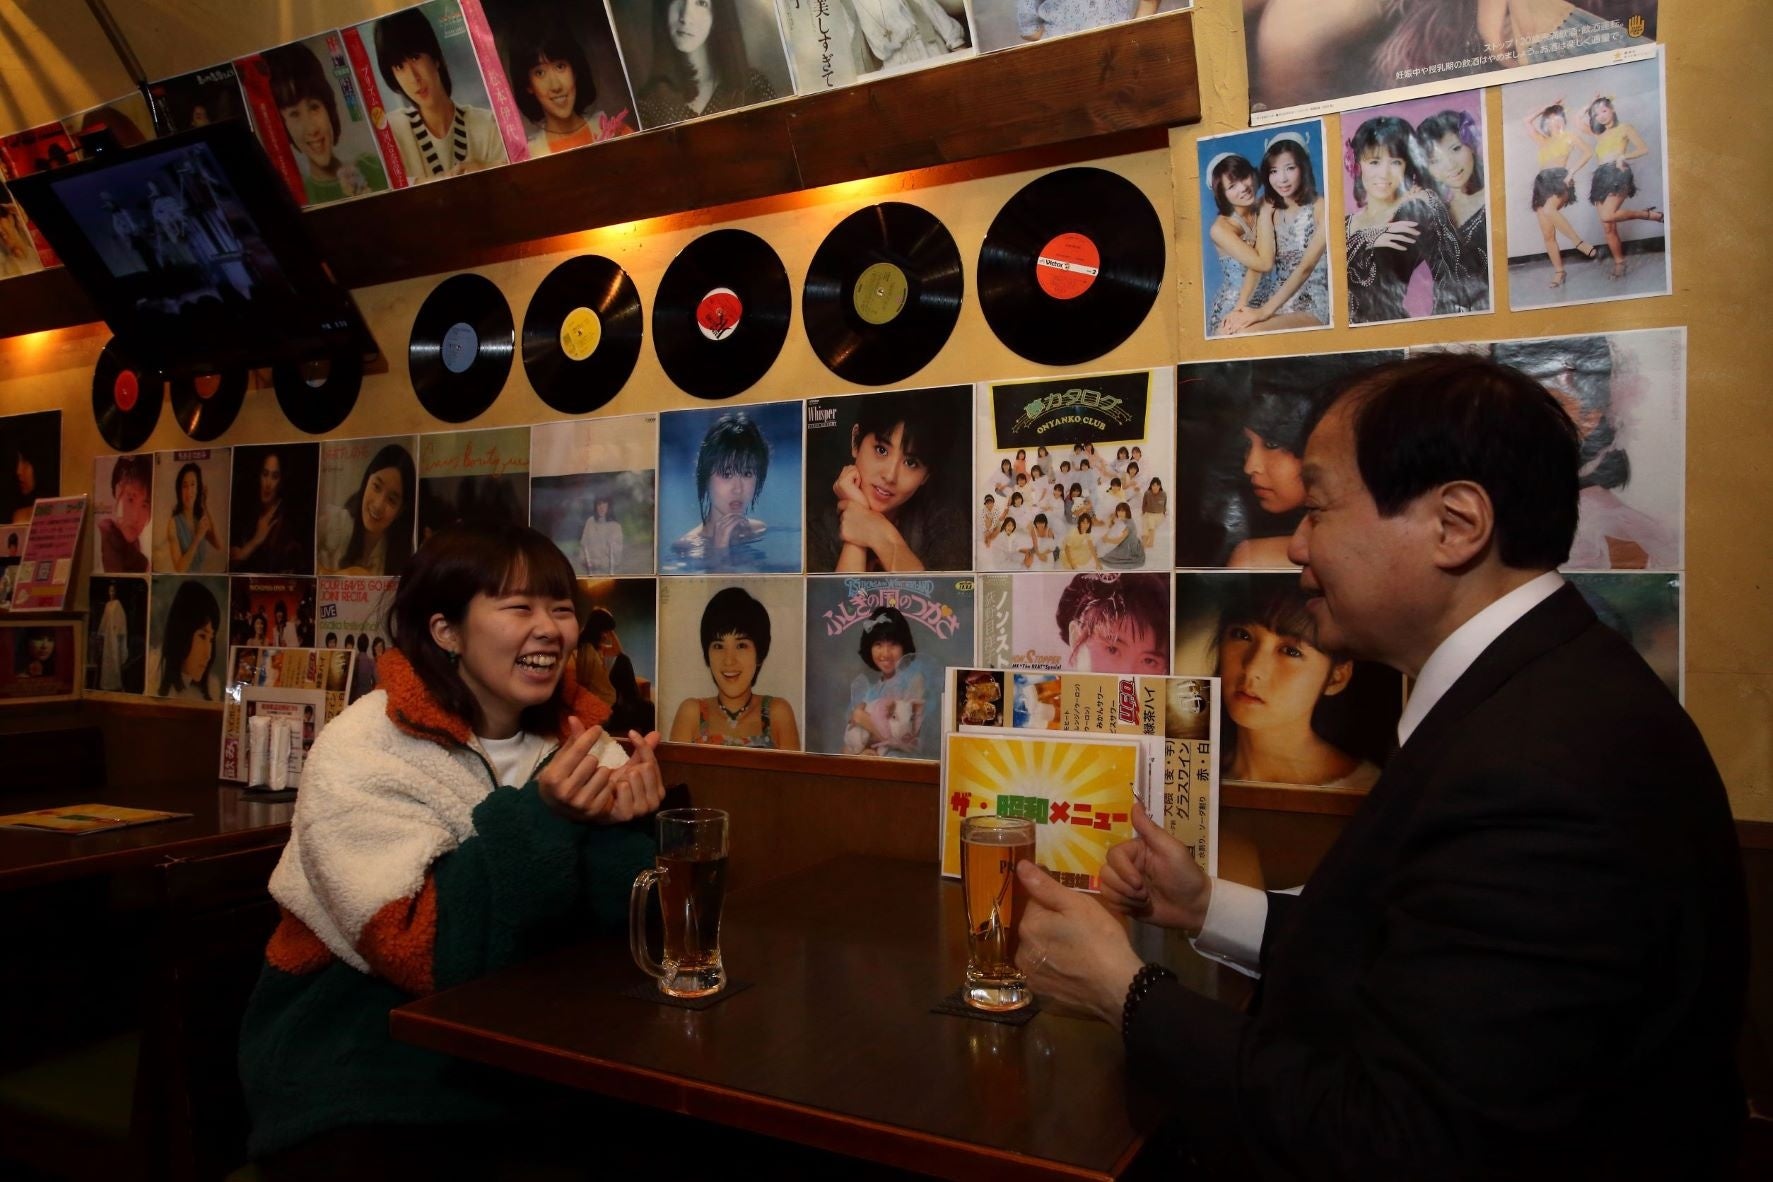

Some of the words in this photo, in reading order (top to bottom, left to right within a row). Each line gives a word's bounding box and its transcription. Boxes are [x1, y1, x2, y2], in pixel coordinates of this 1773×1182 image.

[807, 406, 838, 422] Whisper
[1036, 415, 1081, 434] ONYANKO
[1082, 414, 1107, 431] CLUB
[1176, 742, 1190, 819] グラスワイン
